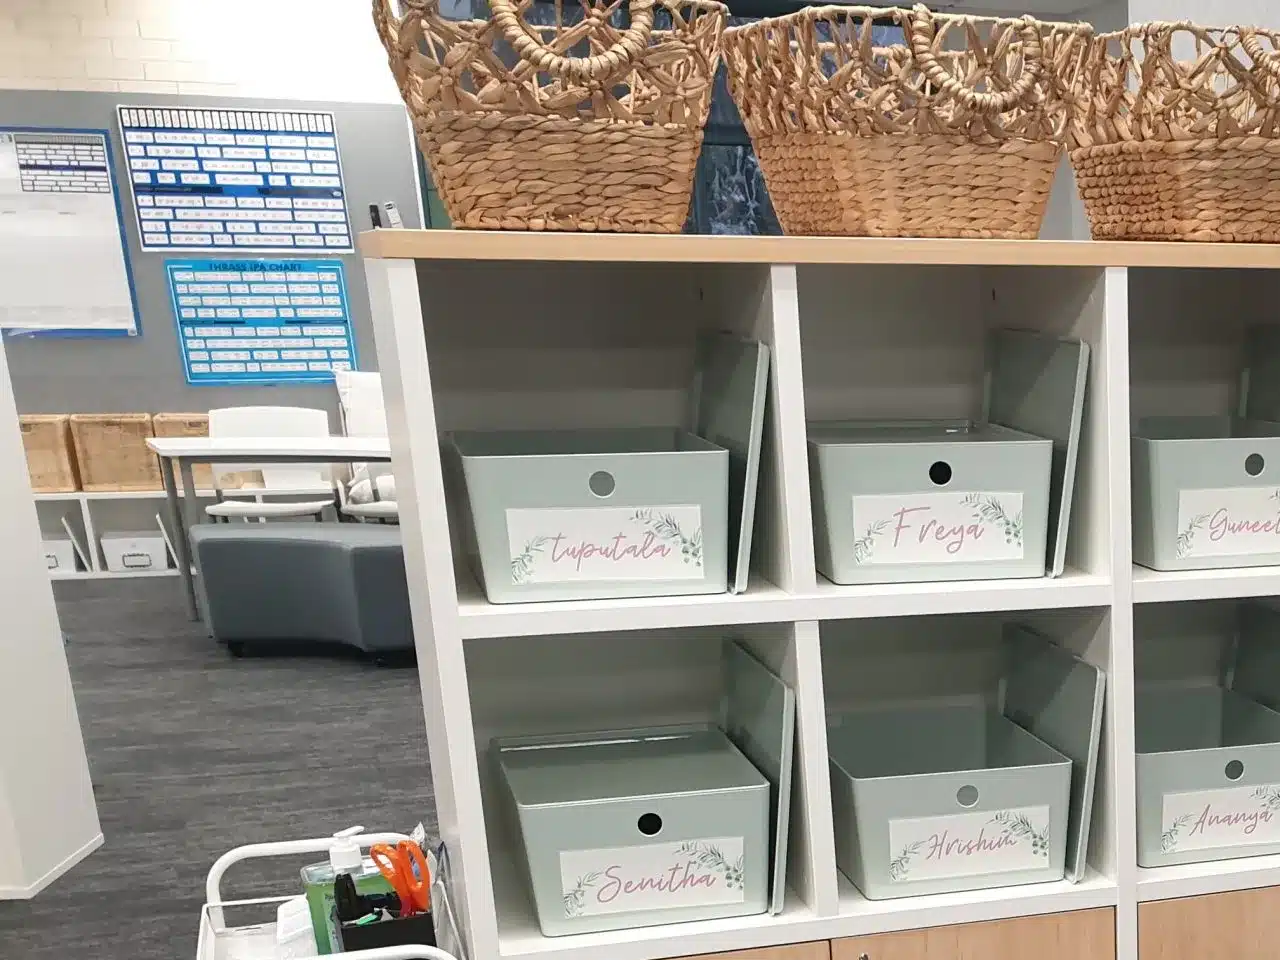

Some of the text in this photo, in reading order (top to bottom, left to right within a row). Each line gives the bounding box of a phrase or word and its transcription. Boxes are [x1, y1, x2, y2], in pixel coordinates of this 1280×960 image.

[549, 529, 672, 571] tuputala
[893, 506, 984, 554] Freya
[1188, 803, 1275, 835] Ananya
[596, 861, 718, 904] Senitha
